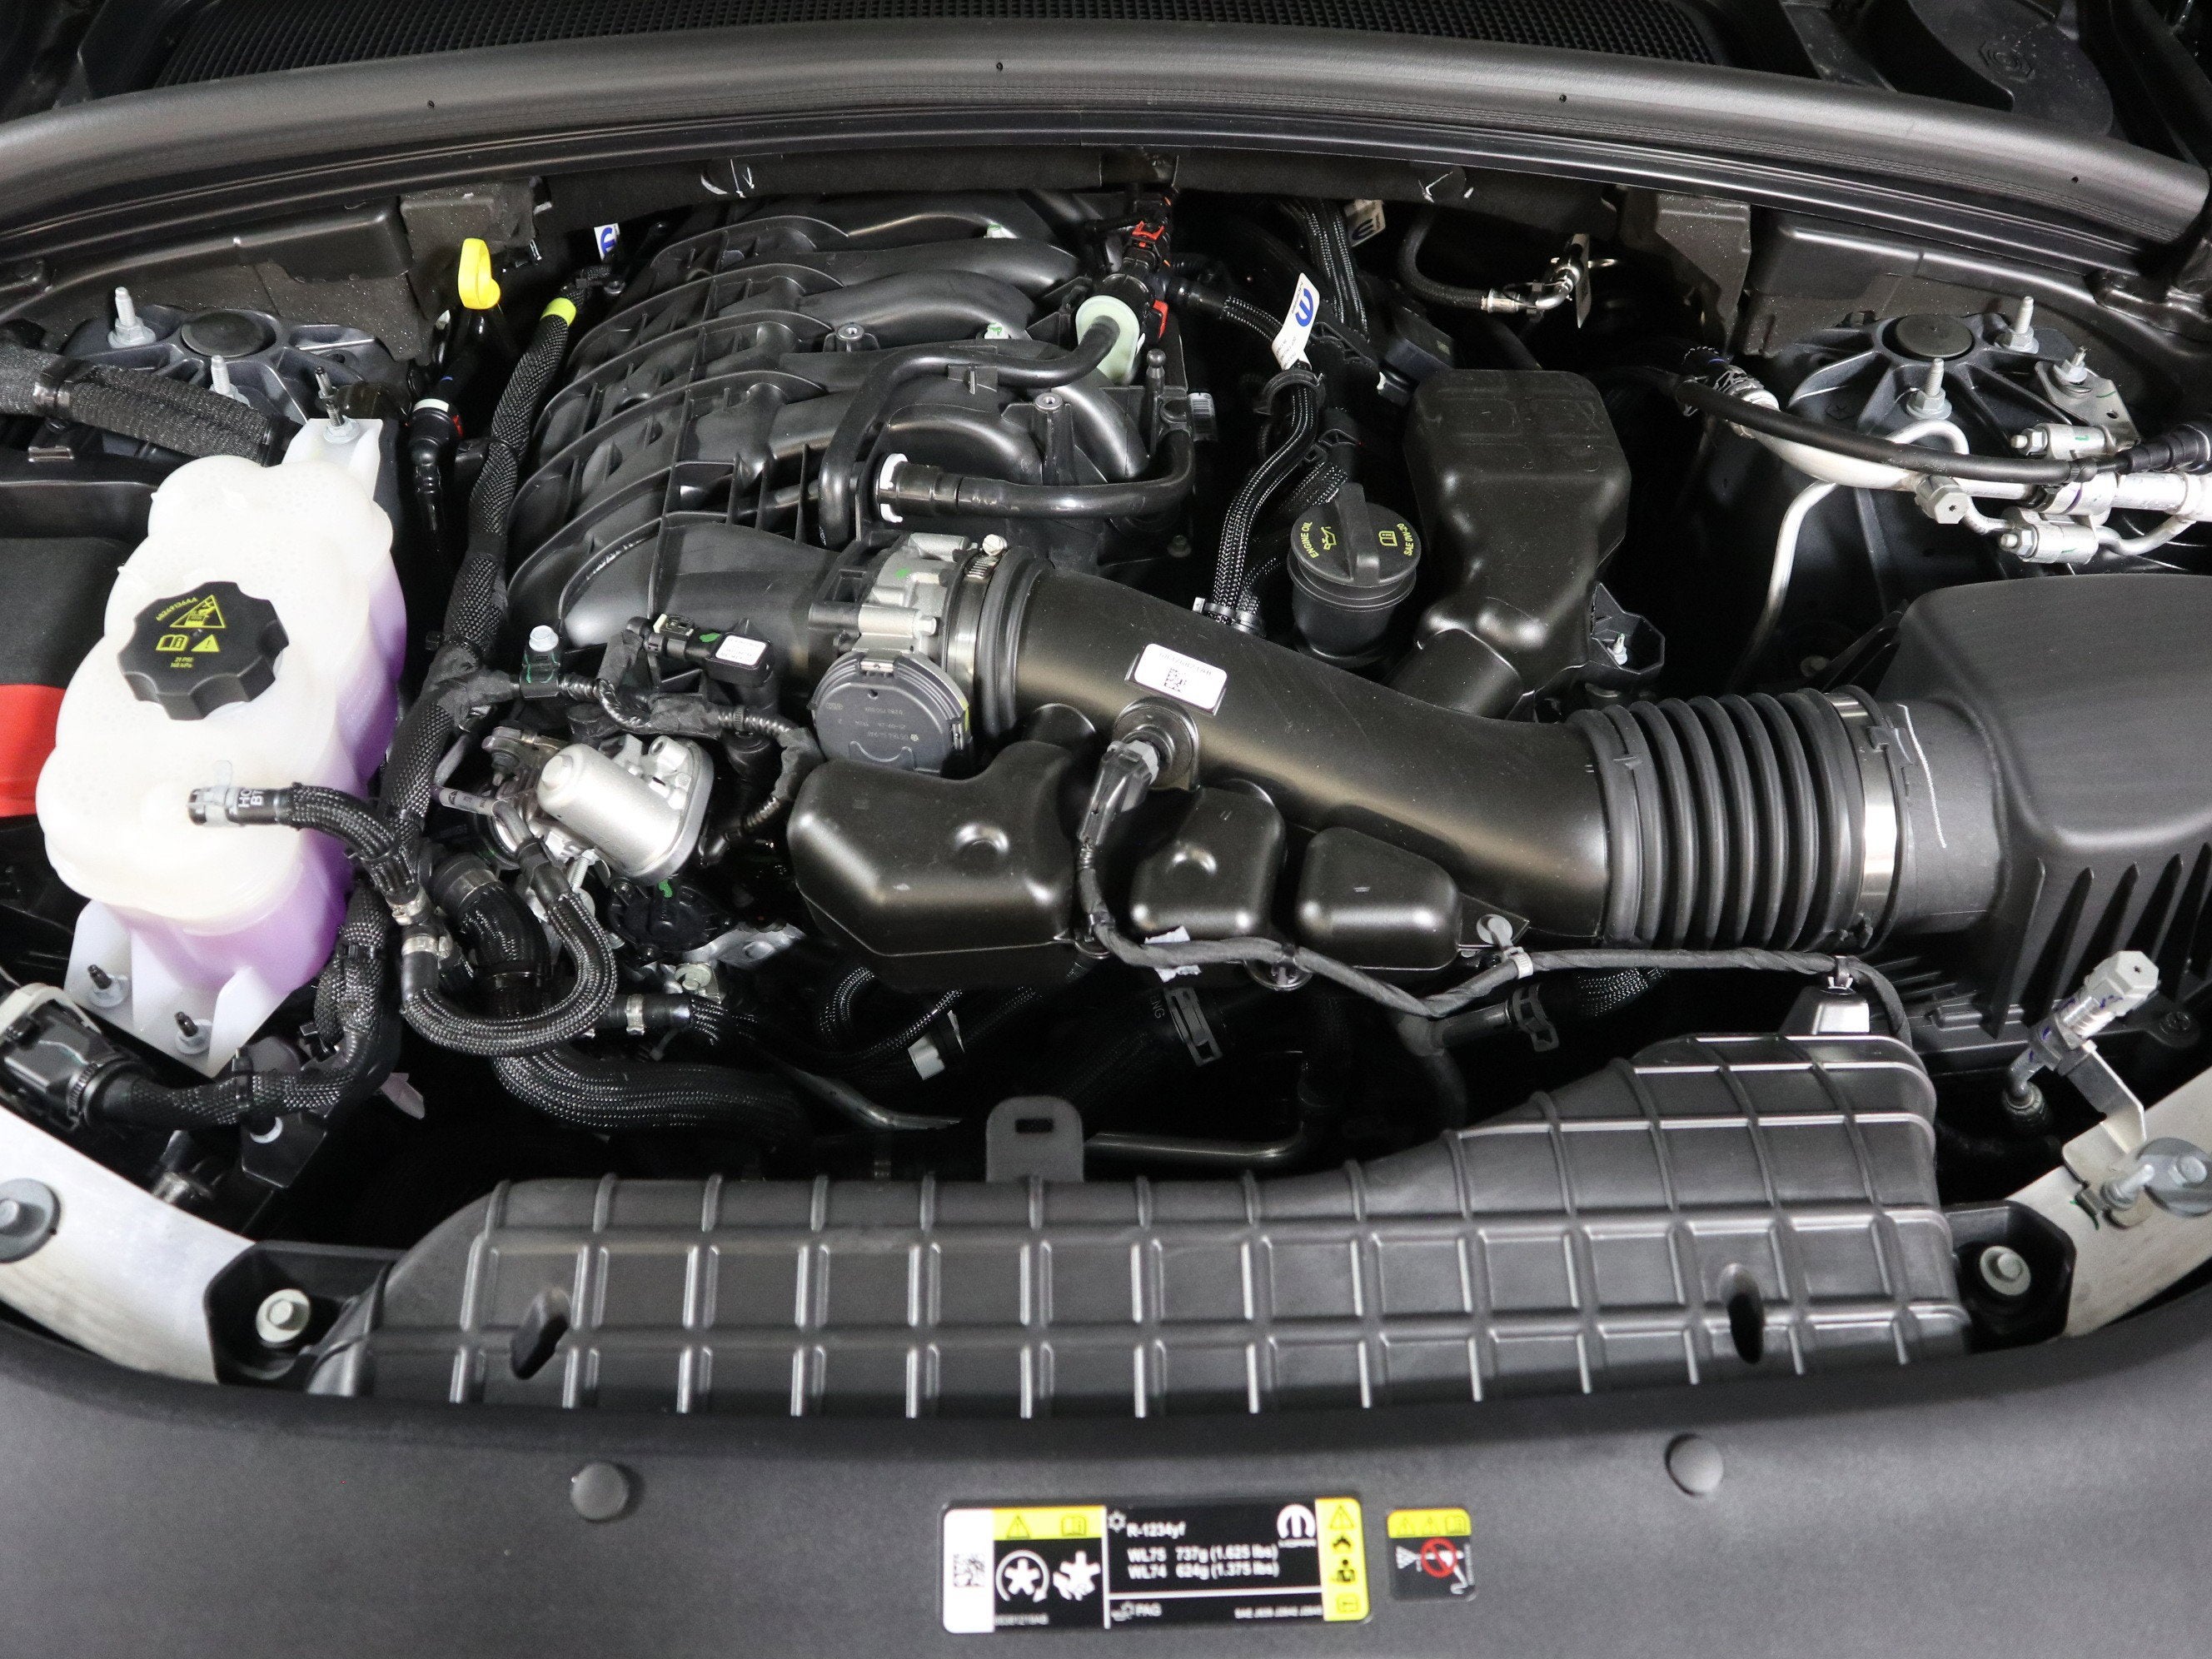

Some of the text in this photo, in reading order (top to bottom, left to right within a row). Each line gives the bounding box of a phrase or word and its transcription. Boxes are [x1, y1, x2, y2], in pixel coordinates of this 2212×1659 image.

[1301, 521, 1319, 559] ENGINE OIL
[1403, 542, 1414, 556] SAE
[1126, 1521, 1187, 1539] R-1234yf
[1127, 1546, 1167, 1562] WL75
[1175, 1545, 1208, 1563] 737g
[1210, 1544, 1251, 1562] (1.625
[1251, 1542, 1279, 1562] lbs)
[1127, 1559, 1280, 1581] WL74 624g (1.375 lbs)
